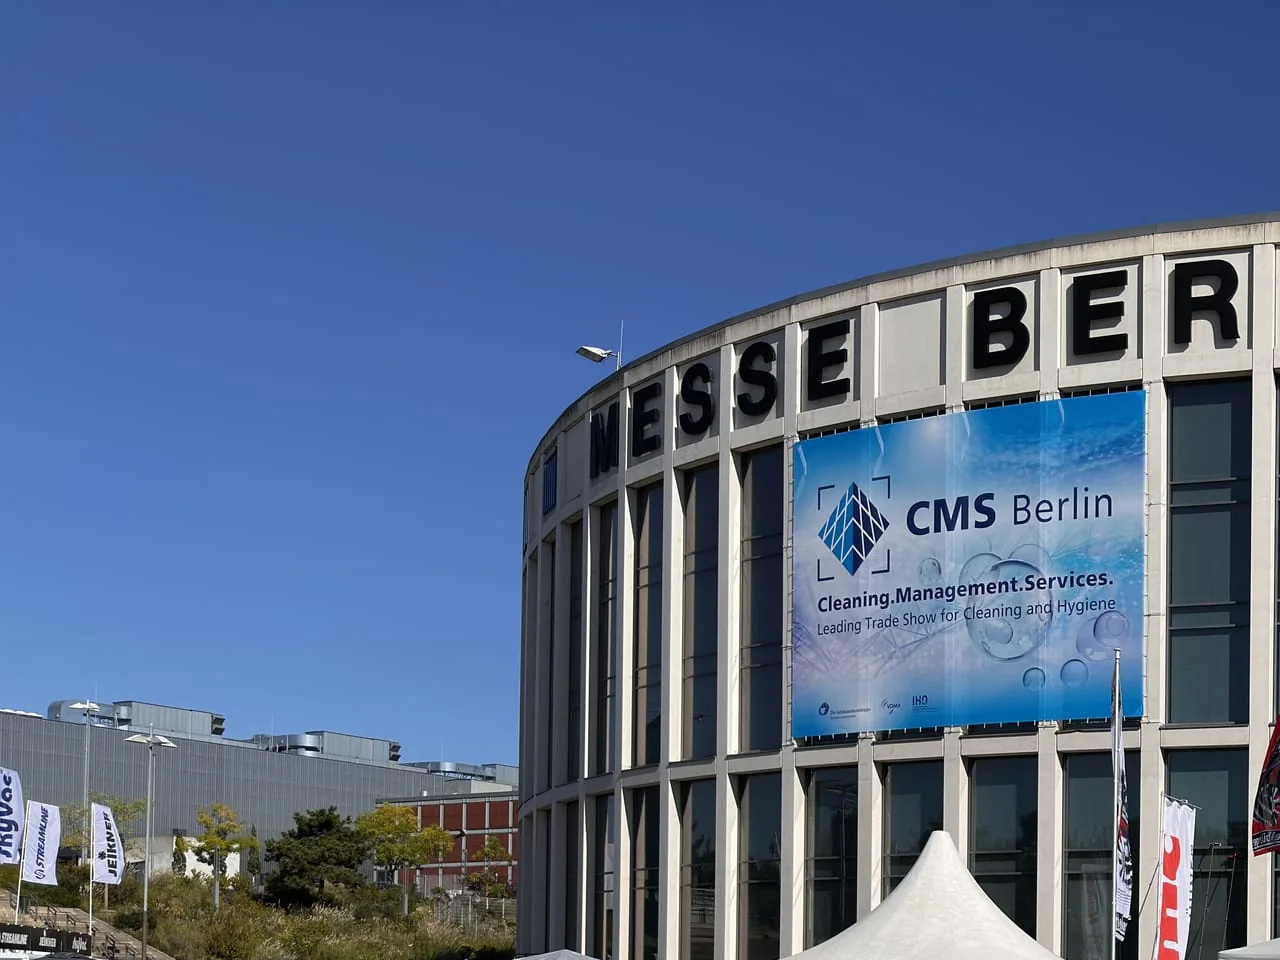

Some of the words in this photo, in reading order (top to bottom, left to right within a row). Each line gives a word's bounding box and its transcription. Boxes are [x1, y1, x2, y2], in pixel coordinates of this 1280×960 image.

[590, 319, 851, 478] MESSE
[906, 493, 996, 536] CMS
[1013, 487, 1113, 525] Berlin
[817, 617, 862, 636] Leading
[865, 614, 899, 630] Trade
[903, 610, 936, 626] Show
[941, 609, 959, 623] for
[963, 603, 1023, 622] Cleaning
[1026, 601, 1051, 616] and
[1057, 597, 1116, 616] Hygiene
[912, 695, 928, 706] IHO
[36, 806, 49, 868] STREAMLINE
